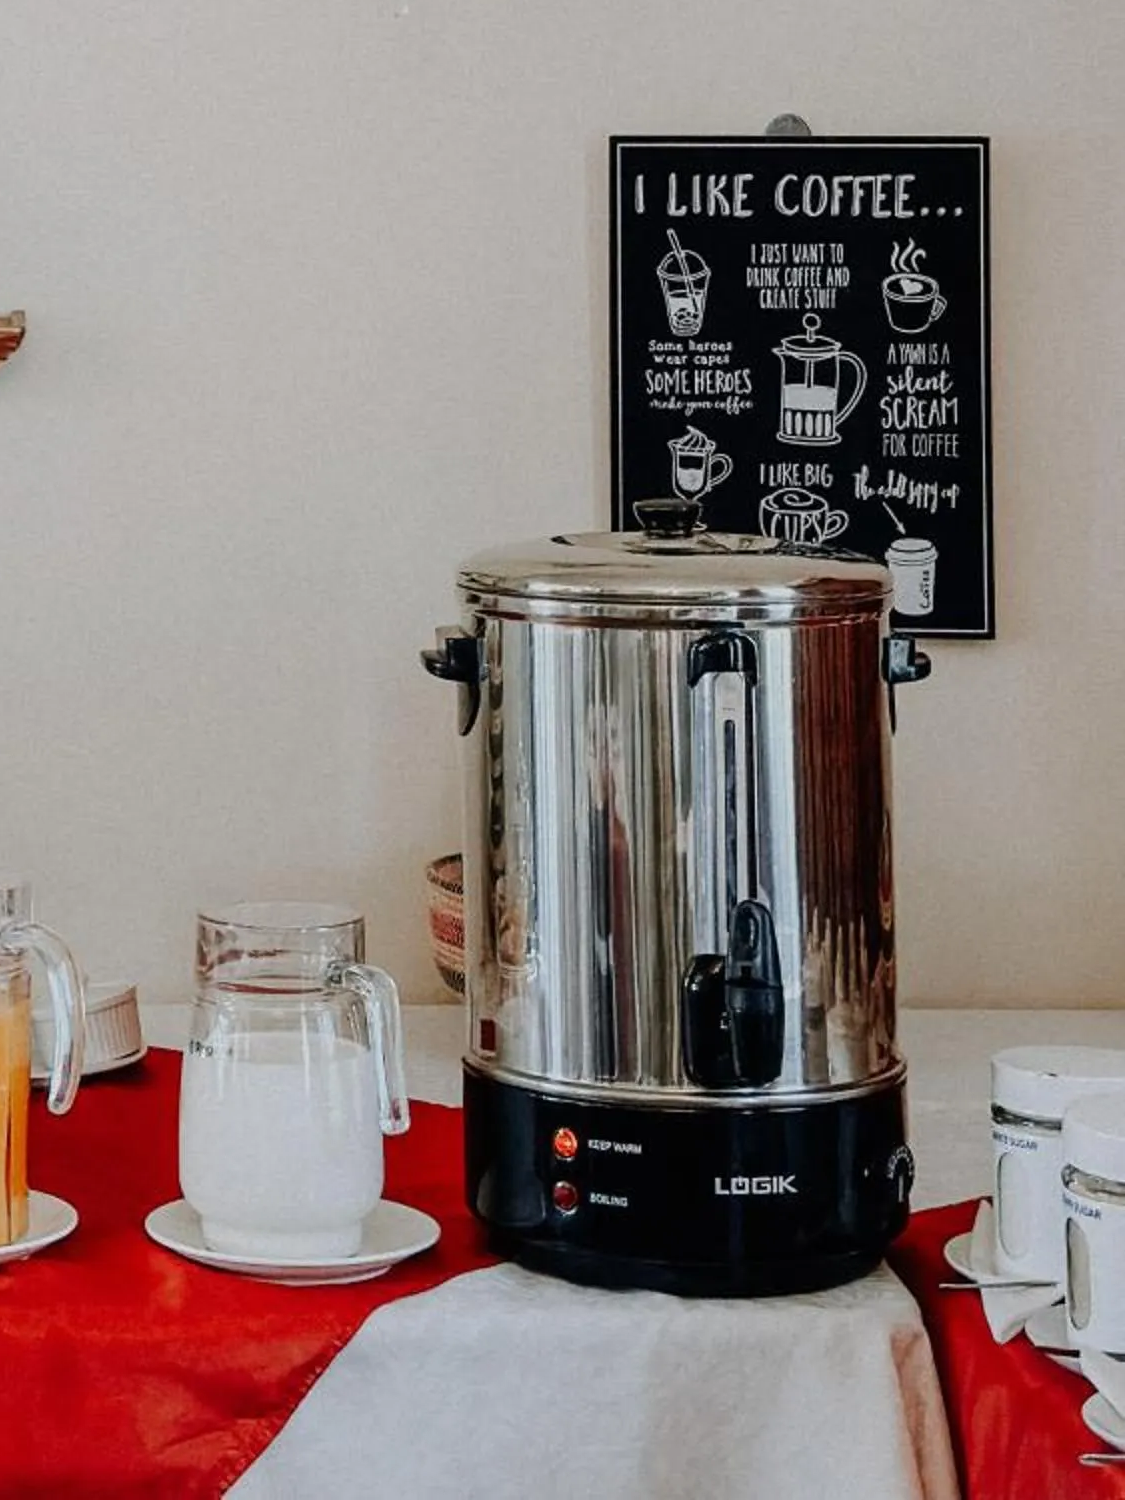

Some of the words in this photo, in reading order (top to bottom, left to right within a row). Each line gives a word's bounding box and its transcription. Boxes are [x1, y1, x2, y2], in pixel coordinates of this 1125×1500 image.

[634, 174, 645, 214] I
[666, 172, 754, 218] LIKE
[774, 174, 963, 218] COFFEE...
[750, 243, 756, 264] I
[760, 243, 787, 265] JUST
[792, 243, 825, 265] WANT
[829, 243, 844, 264] TO
[746, 266, 780, 288] DRINK
[784, 266, 822, 287] COFFEE
[826, 266, 850, 287] AND
[760, 288, 800, 309] CREATE
[886, 342, 897, 365] A
[899, 342, 926, 365] YAWN
[928, 342, 938, 365] IS
[941, 342, 950, 365] A
[645, 368, 692, 396] SOME
[694, 368, 752, 395] HEROES
[886, 365, 954, 395] silent
[879, 395, 959, 430] SCREAM
[882, 433, 907, 457] FOR
[912, 433, 960, 458] COFFEE
[759, 462, 765, 485] I
[769, 461, 802, 487] LIKE
[804, 463, 834, 488] BIG
[588, 1139, 612, 1151] KEEP
[613, 1141, 642, 1155] WARM
[714, 1174, 798, 1195] LOGIK
[590, 1192, 628, 1208] BOILING
